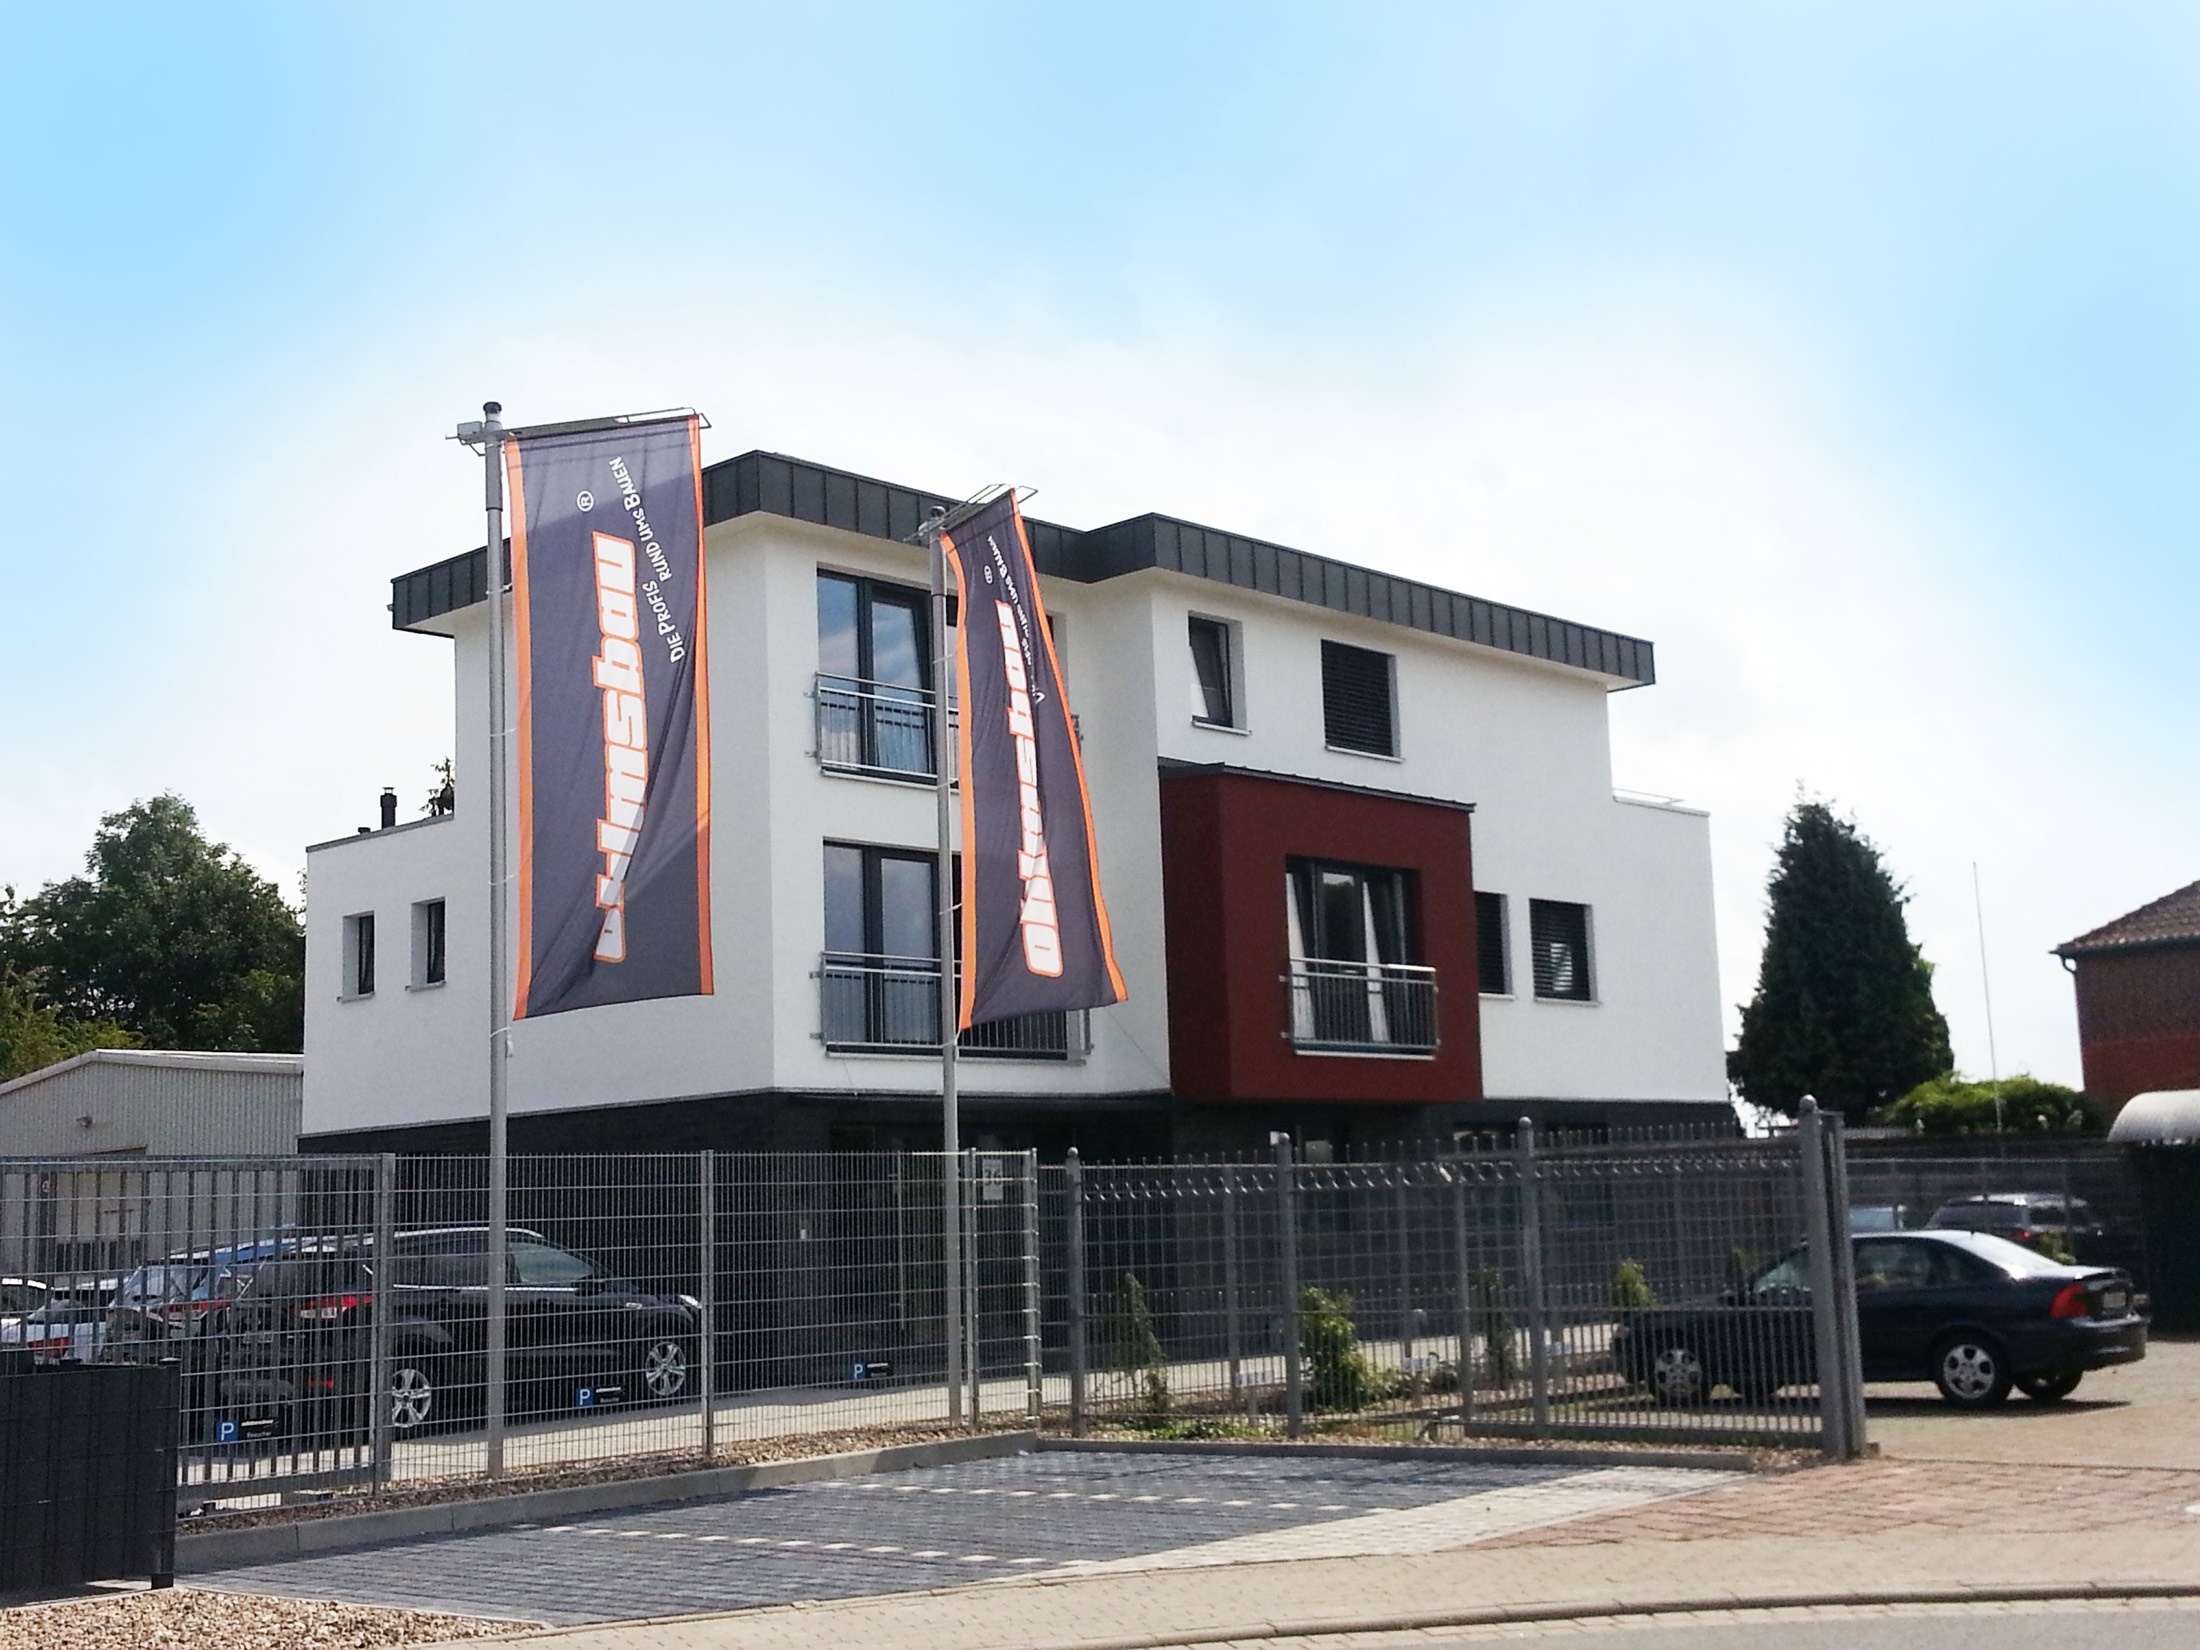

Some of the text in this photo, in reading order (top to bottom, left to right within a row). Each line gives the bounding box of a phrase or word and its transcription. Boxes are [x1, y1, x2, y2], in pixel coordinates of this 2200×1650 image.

[609, 456, 642, 511] BAUEN
[645, 539, 673, 582] RUND
[642, 580, 686, 664] DIE PROFIS
[220, 1422, 234, 1441] P
